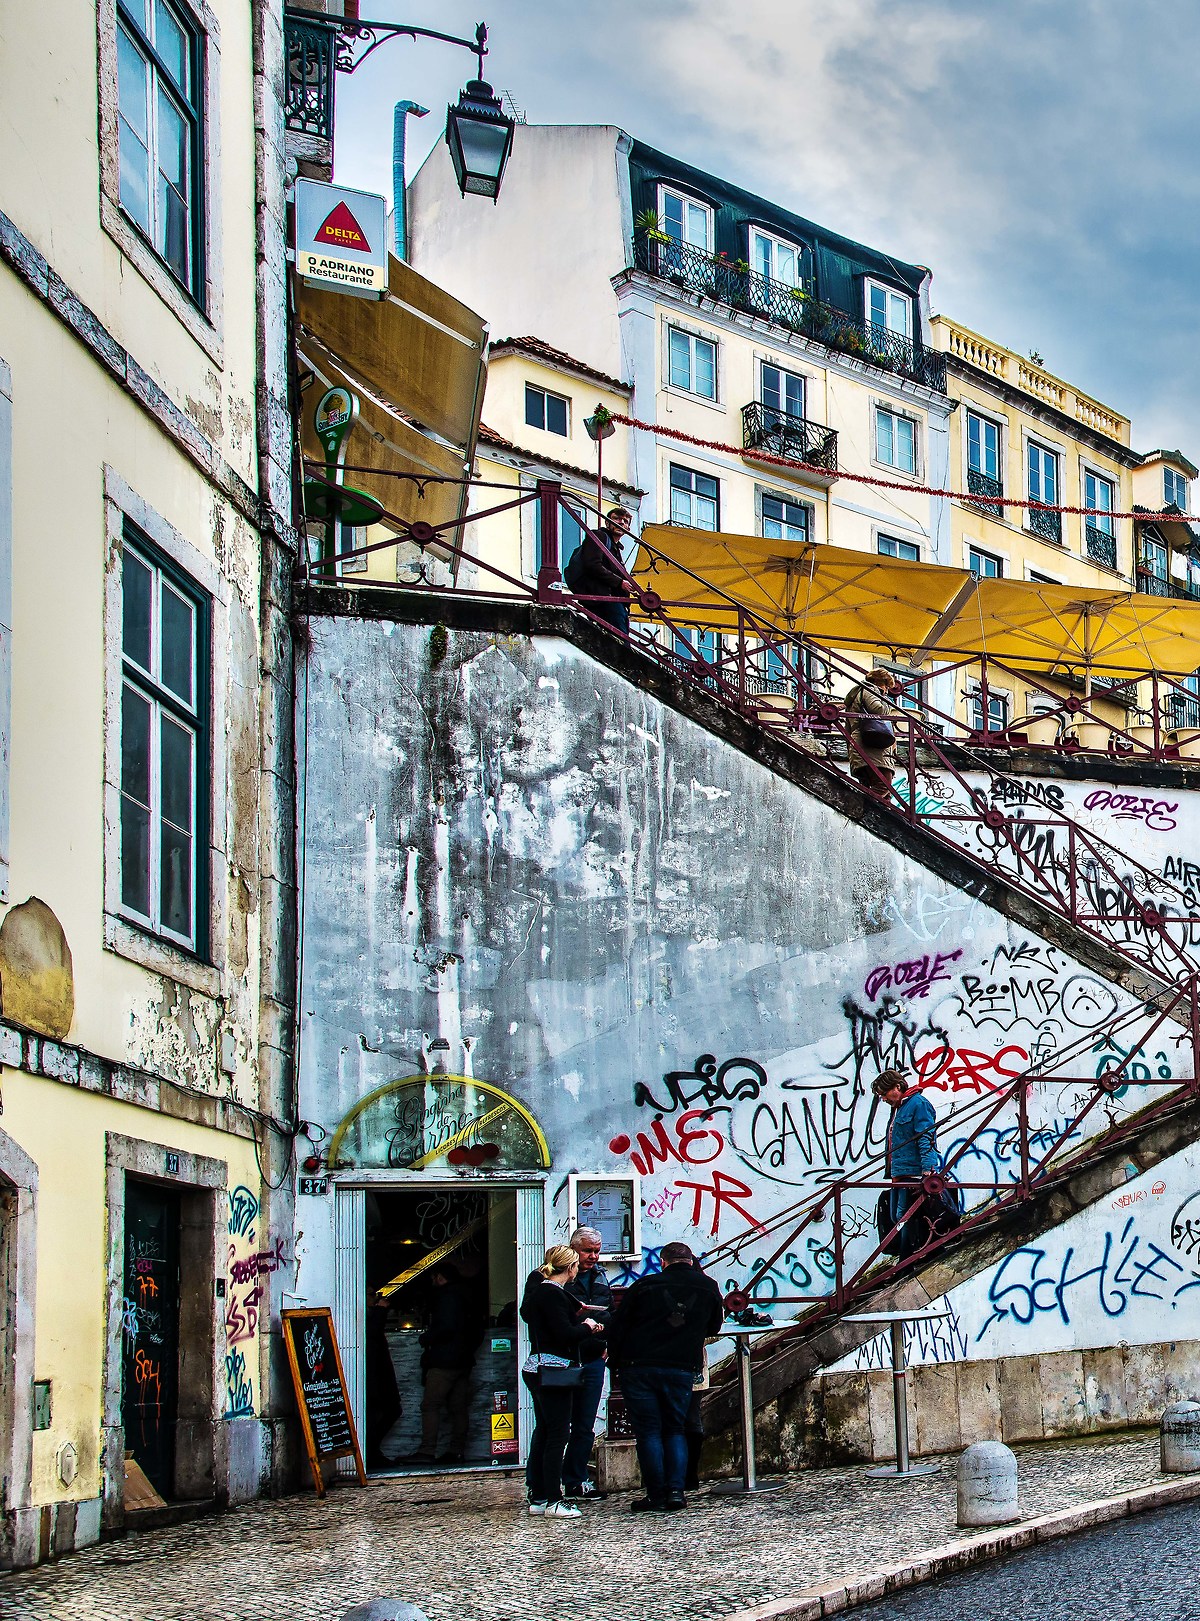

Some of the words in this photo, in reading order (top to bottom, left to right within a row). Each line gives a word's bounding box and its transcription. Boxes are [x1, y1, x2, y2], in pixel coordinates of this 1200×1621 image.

[325, 225, 362, 242] DELTA
[307, 256, 318, 266] O
[319, 259, 375, 277] ADRIANO
[309, 265, 373, 286] Restaurante
[169, 1154, 178, 1171] 37
